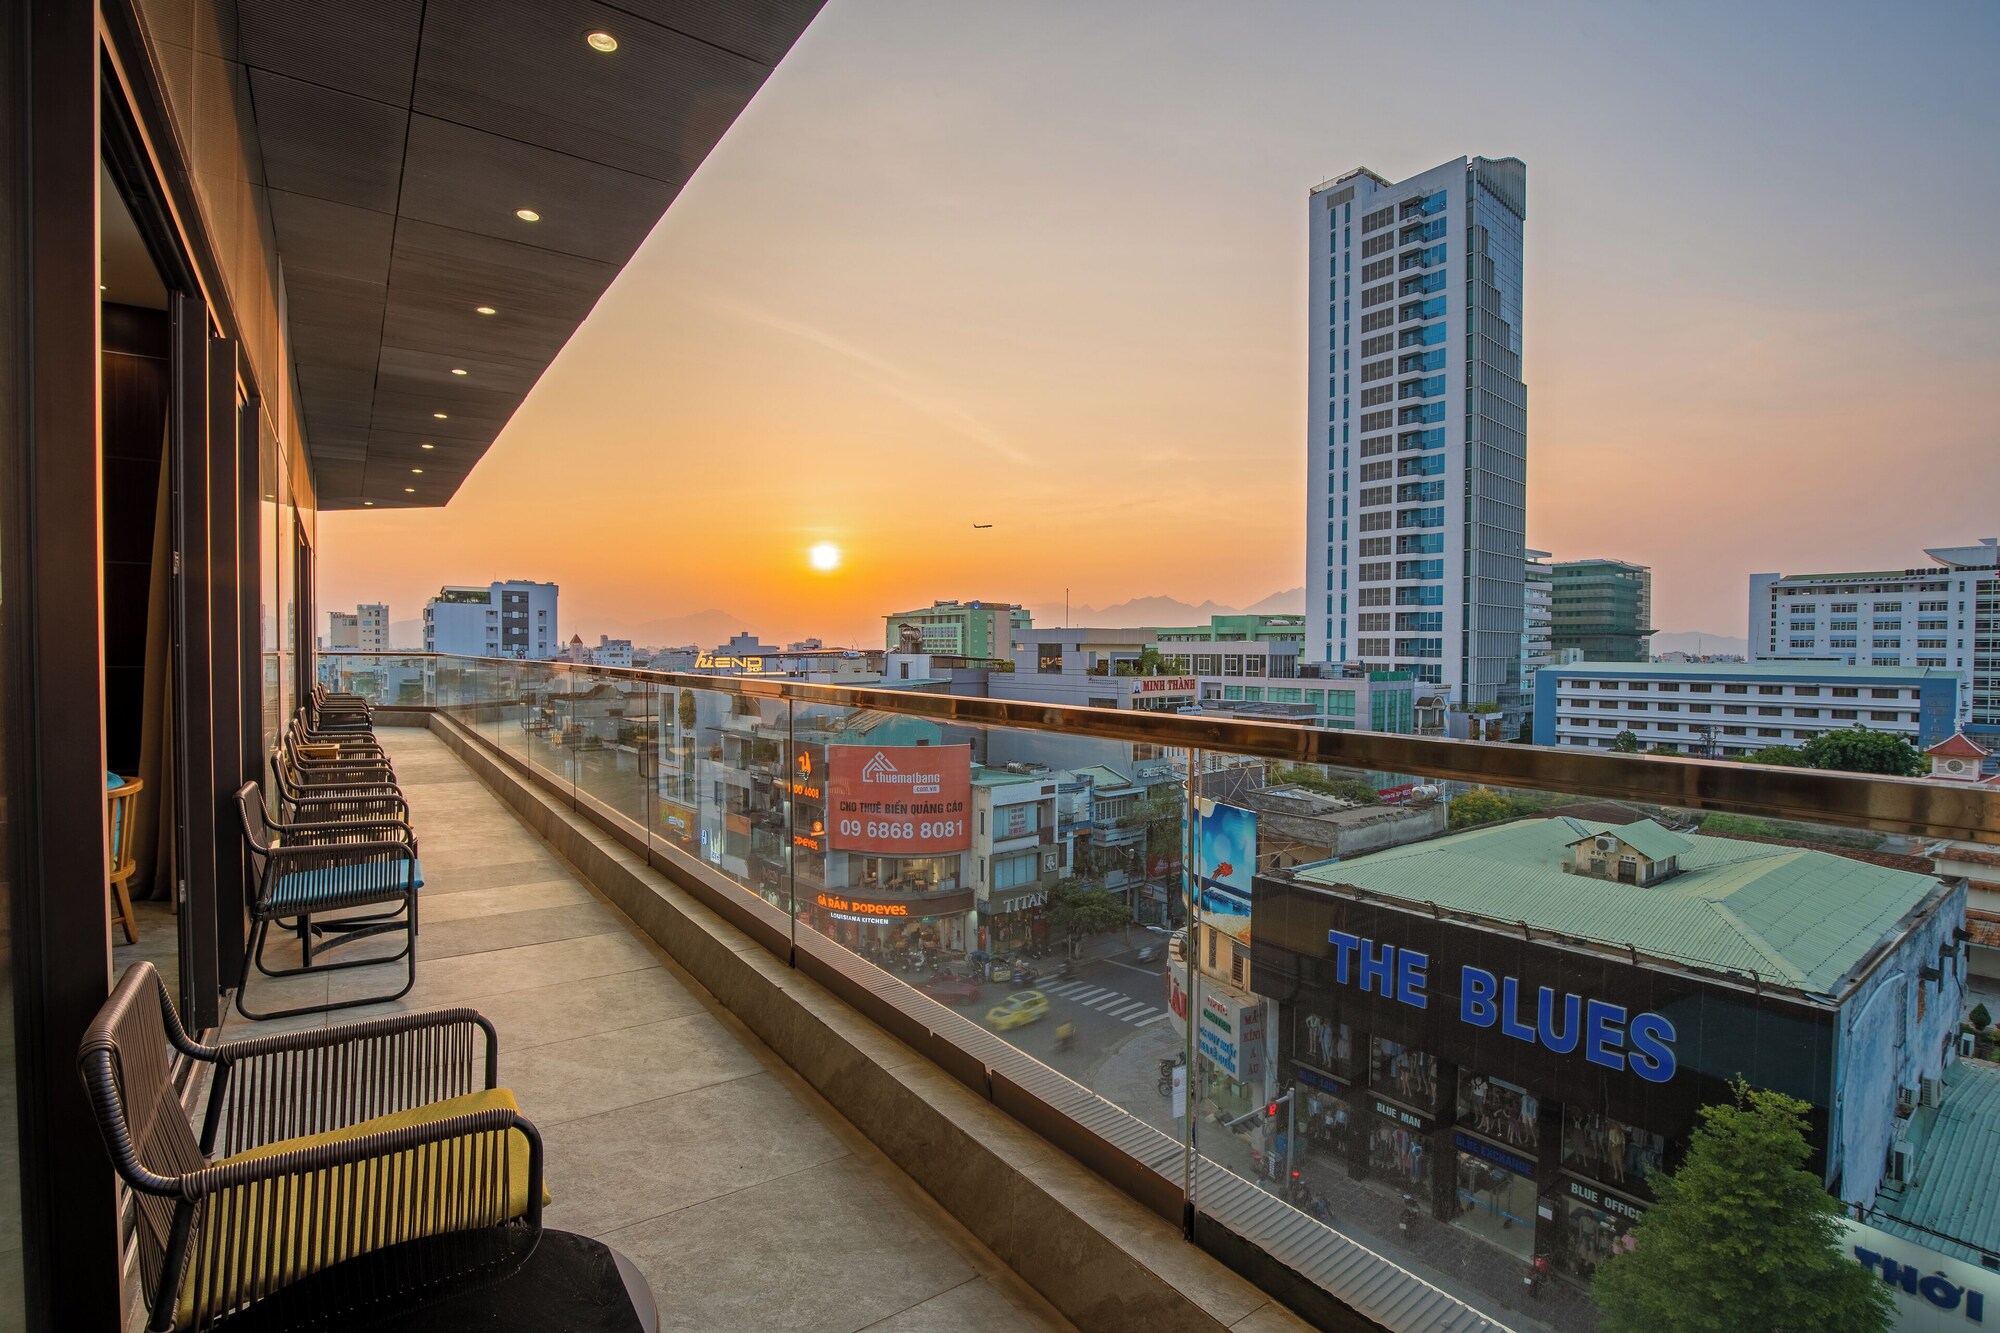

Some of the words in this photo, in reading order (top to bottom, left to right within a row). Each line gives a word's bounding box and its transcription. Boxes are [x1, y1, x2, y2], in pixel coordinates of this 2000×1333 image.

[1143, 679, 1165, 691] MINH
[1167, 677, 1195, 690] THÀNH
[840, 801, 857, 812] CHO
[859, 801, 881, 814] THUÊ
[885, 800, 907, 815] BIỂN
[911, 801, 944, 816] QUẢNG
[946, 800, 963, 813] CÁO
[840, 820, 861, 836] 09
[867, 821, 914, 839] 6868
[920, 820, 963, 839] 8081
[817, 894, 827, 907] GÀ
[828, 896, 849, 911] RÁN
[1003, 891, 1048, 913] TITAN
[830, 912, 861, 923] LOUISIANA
[862, 917, 889, 925] KITCHEN
[1328, 929, 1429, 1010] THE
[1460, 965, 1677, 1083] BLUES
[1376, 1102, 1397, 1118] BLUE
[1400, 1112, 1421, 1128] MAN
[1456, 1135, 1479, 1153] BLUE
[1571, 1182, 1598, 1203] BLUE
